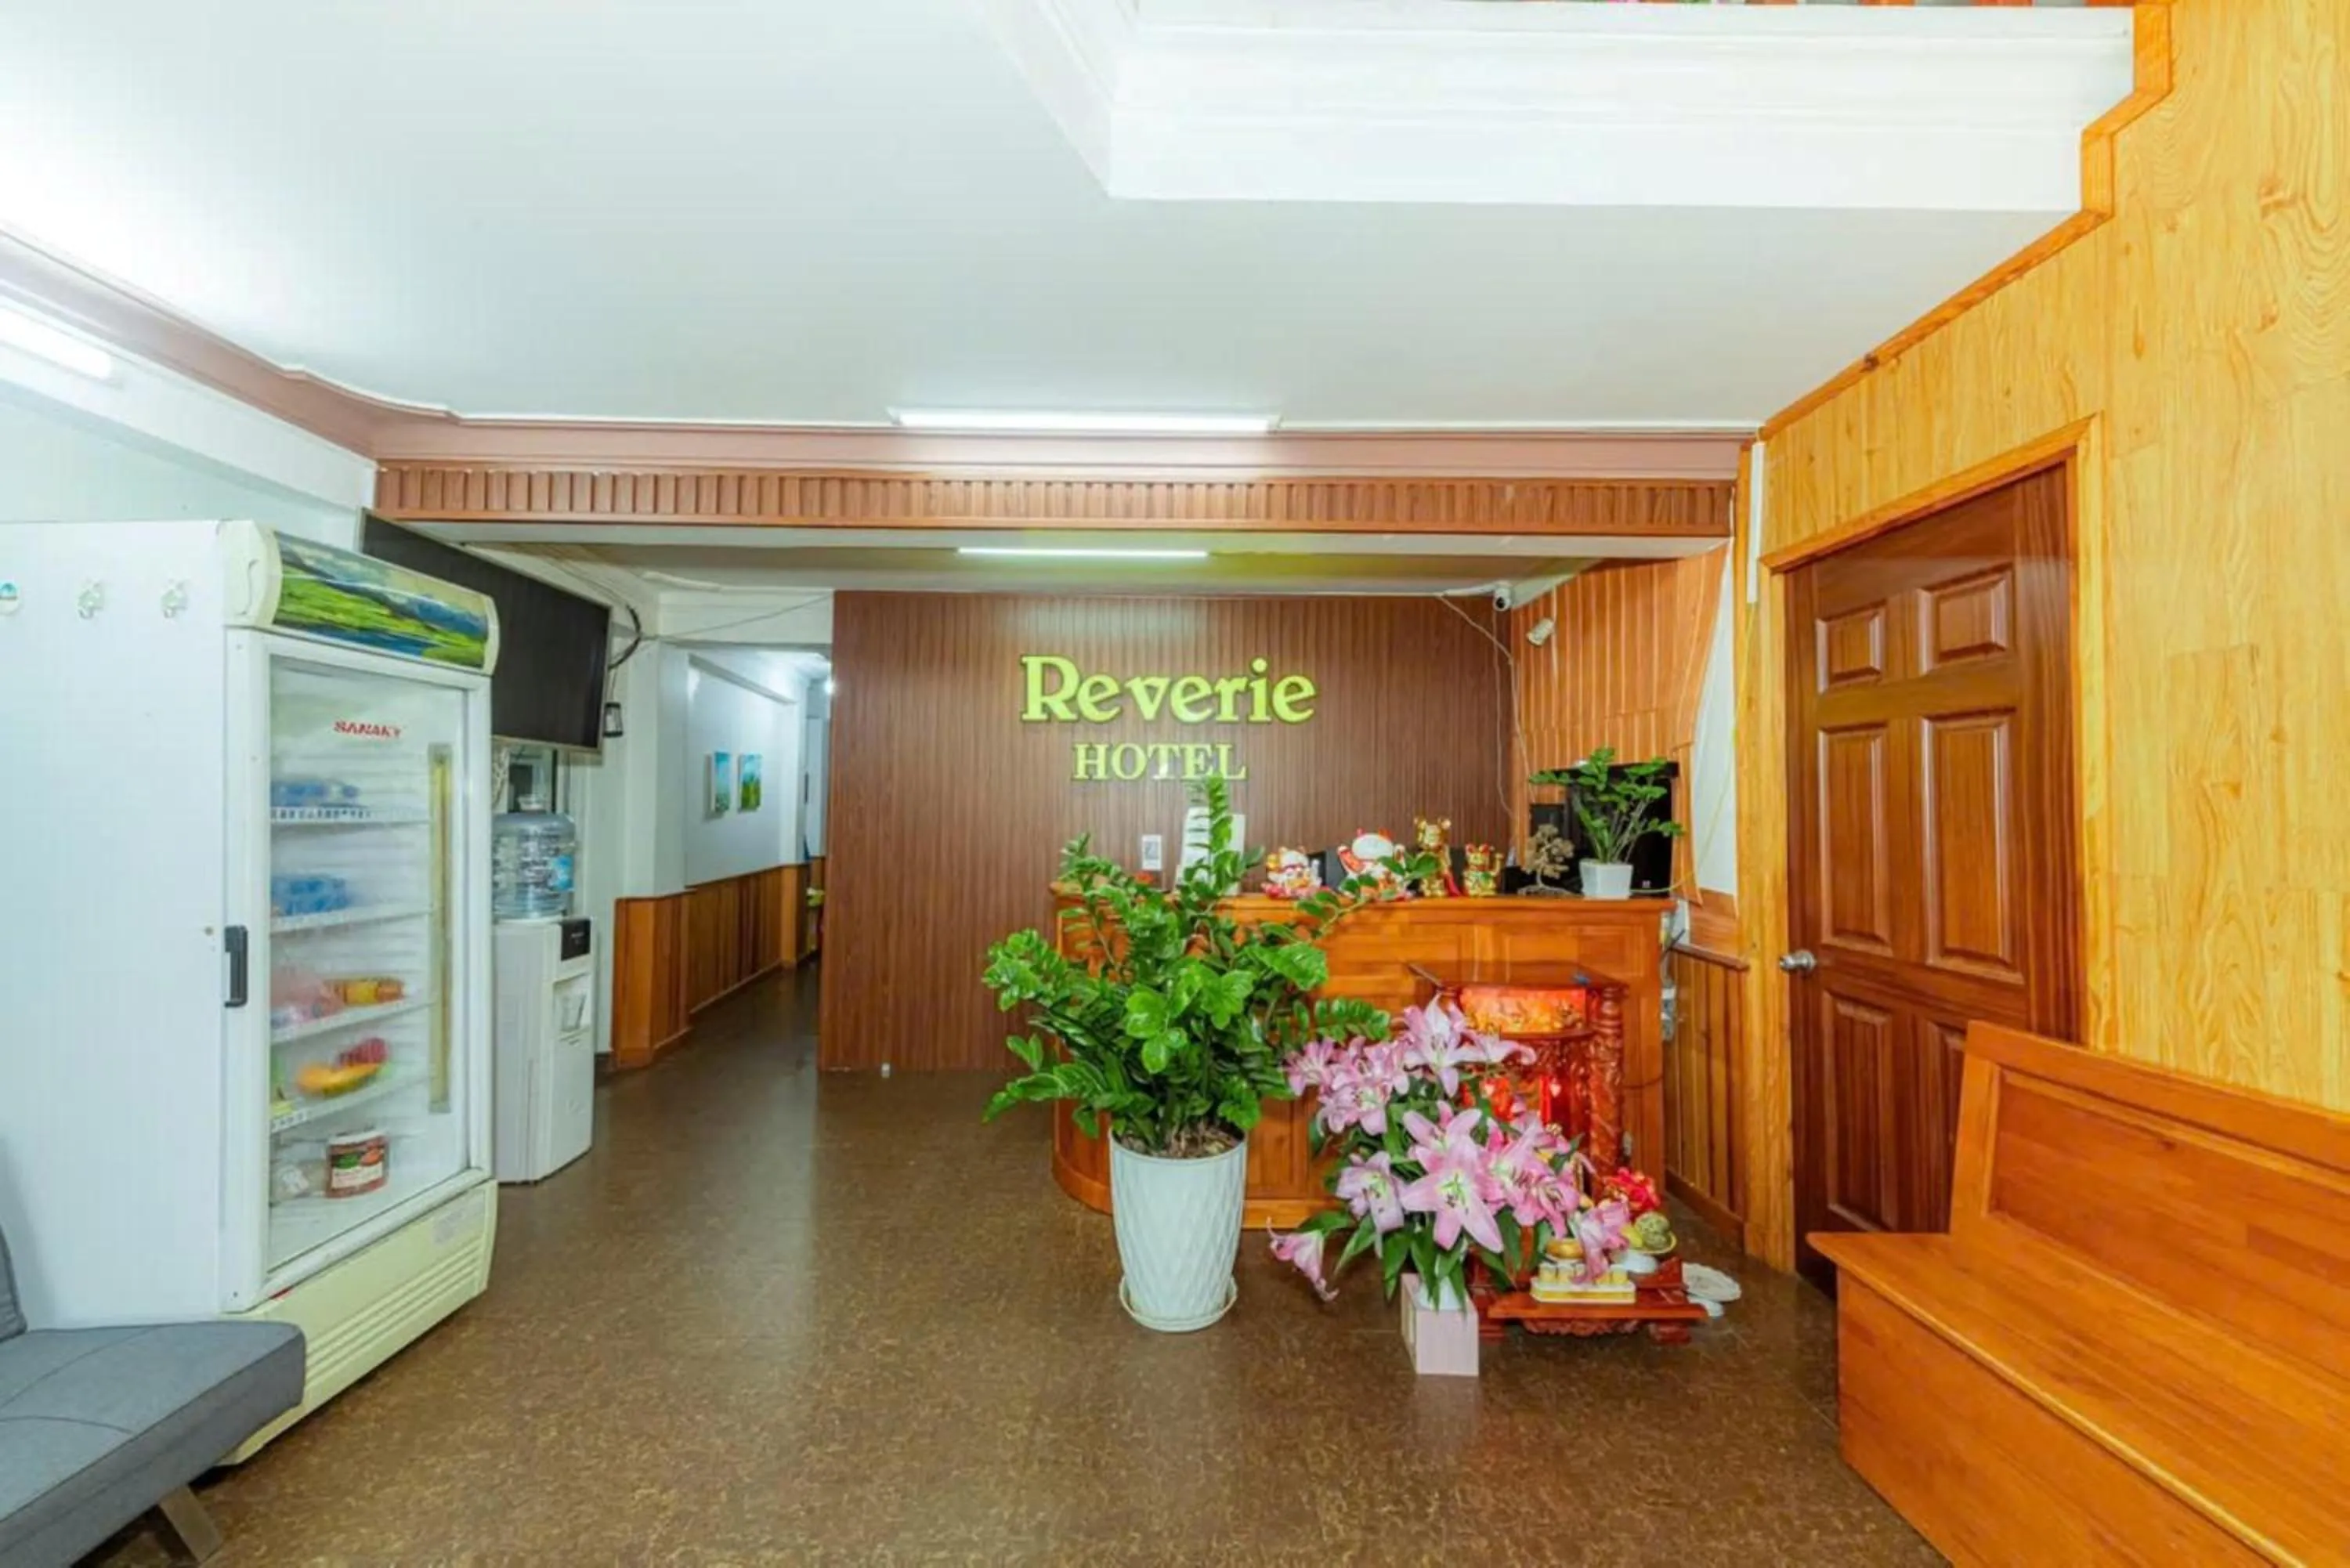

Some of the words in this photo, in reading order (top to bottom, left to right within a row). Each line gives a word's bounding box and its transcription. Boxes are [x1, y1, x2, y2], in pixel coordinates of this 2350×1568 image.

[1021, 655, 1317, 724] Reverie
[334, 720, 401, 738] SANAKY
[1072, 742, 1248, 782] HOTEL
